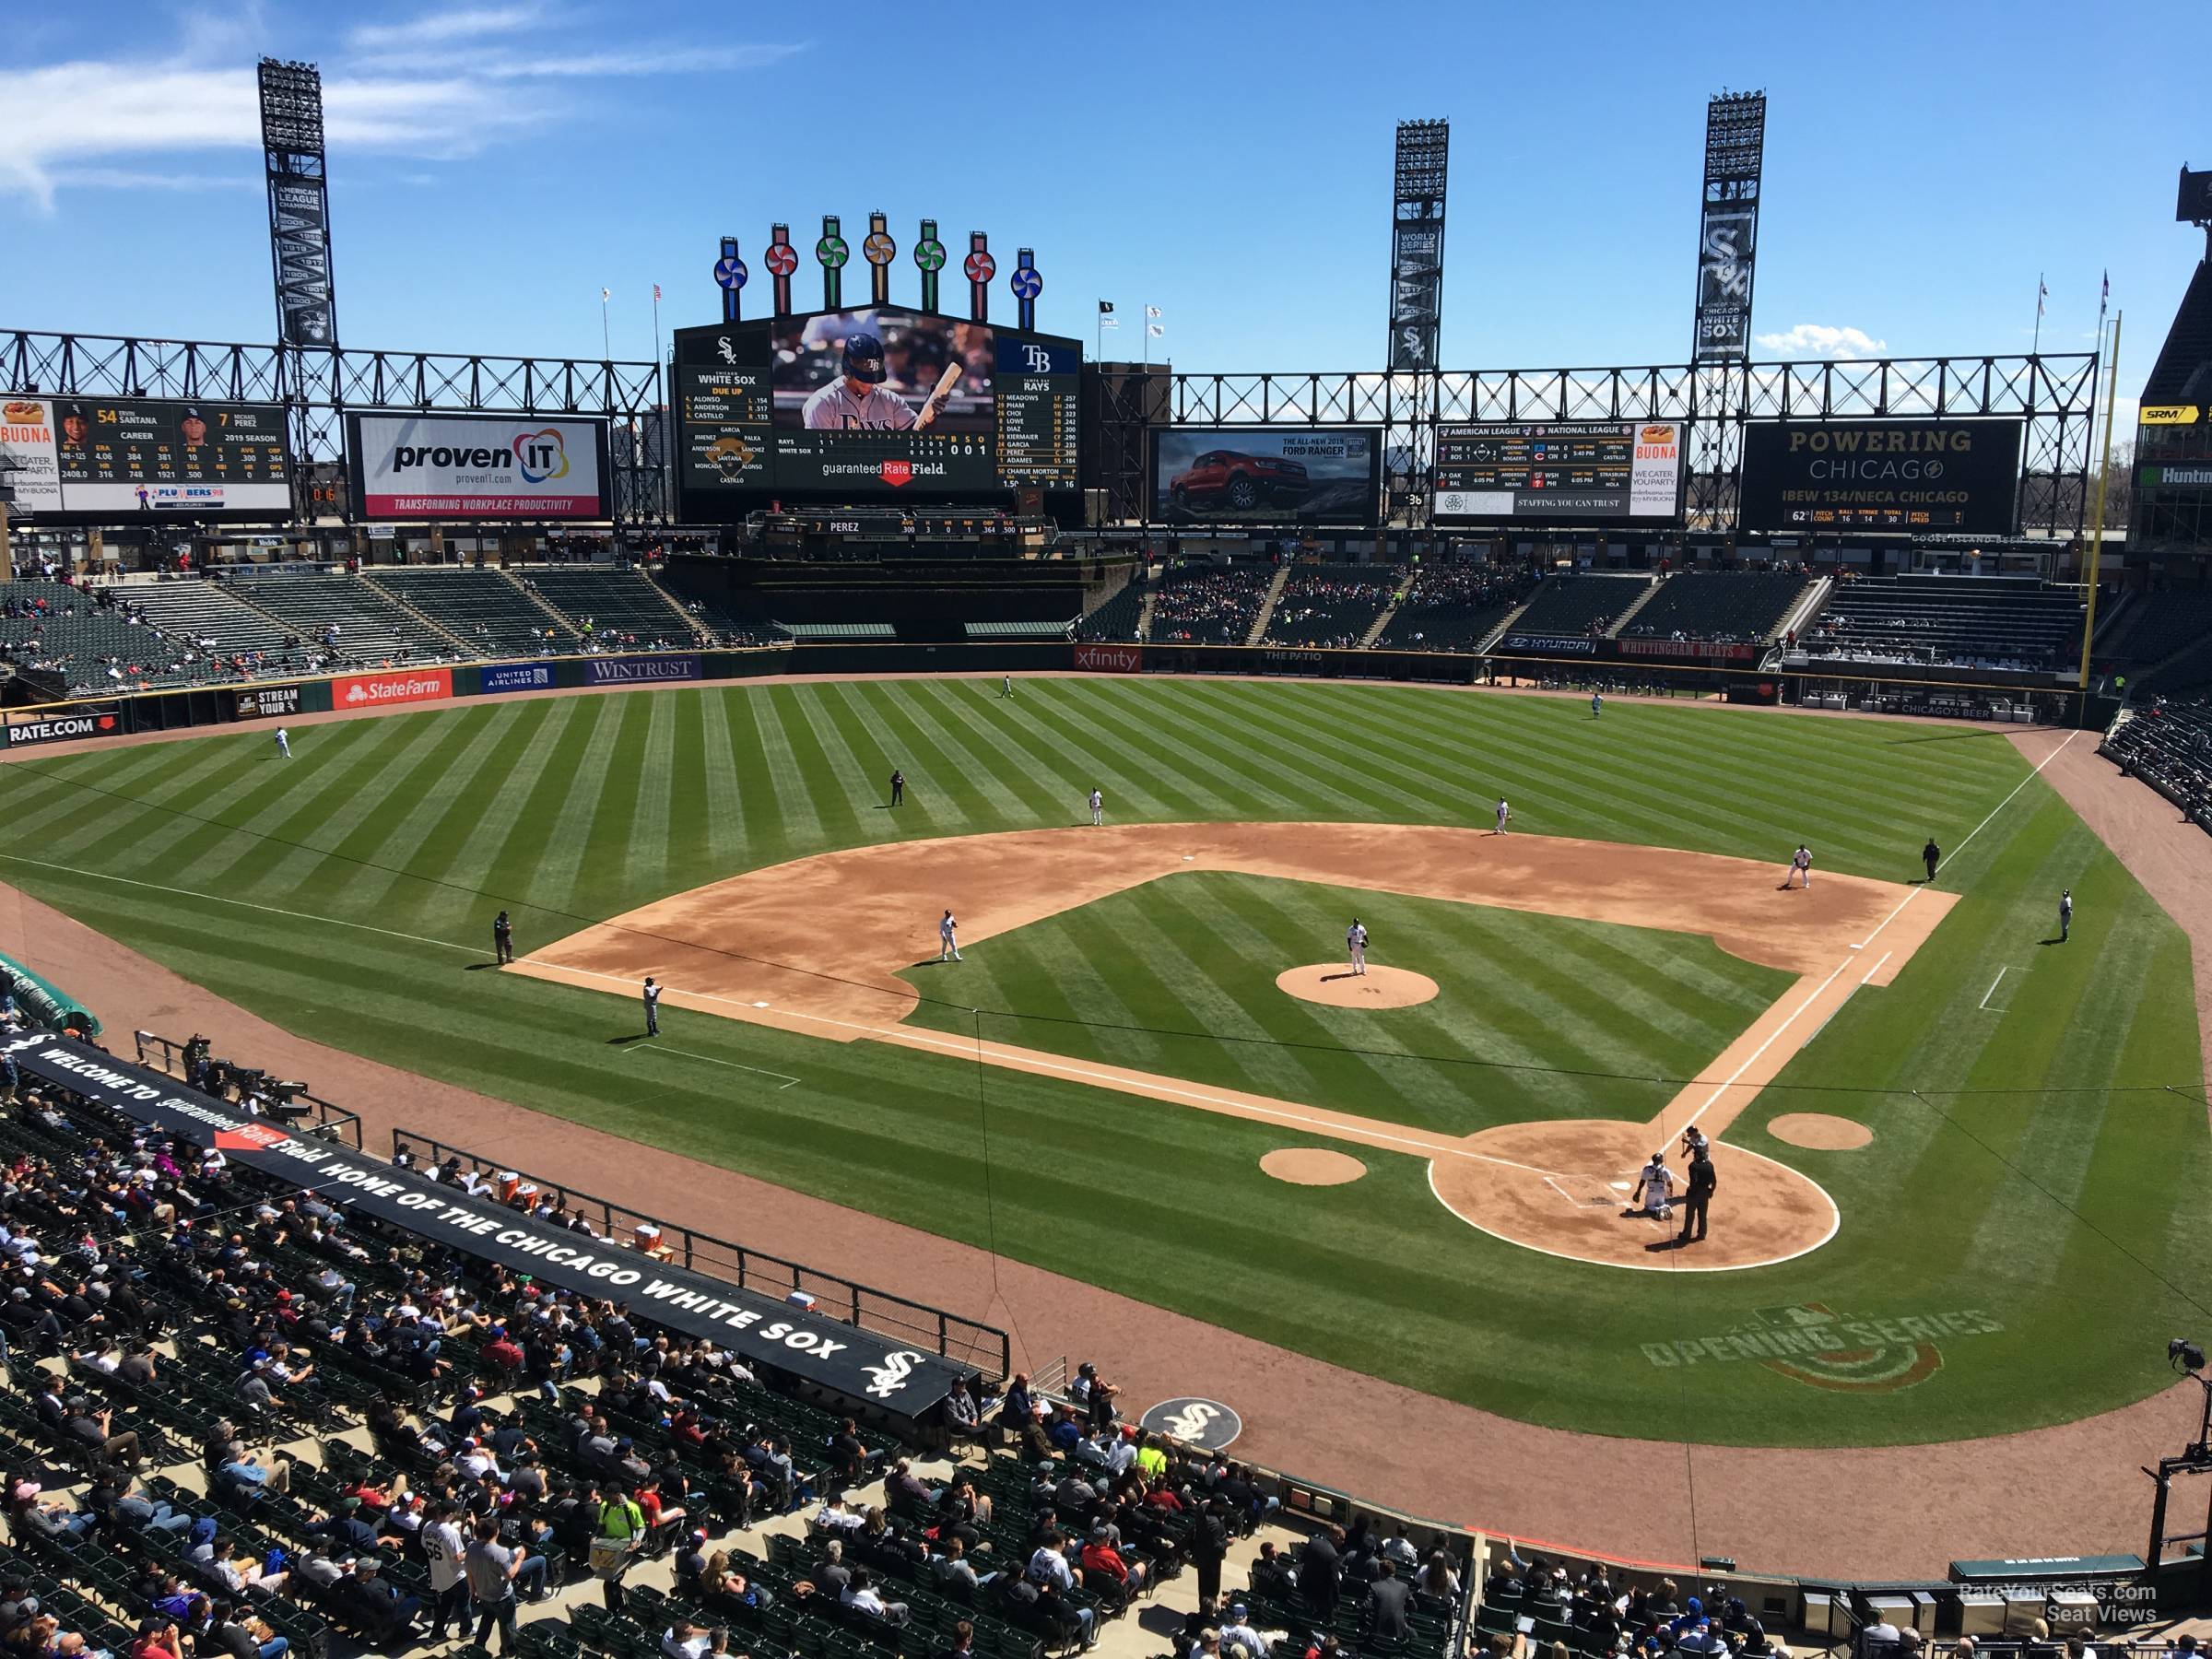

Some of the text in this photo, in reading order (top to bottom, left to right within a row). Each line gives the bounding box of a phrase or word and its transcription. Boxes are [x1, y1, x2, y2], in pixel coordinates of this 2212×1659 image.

[279, 187, 319, 196] AMERICAN
[279, 194, 319, 205] LEAGUE
[279, 202, 320, 211] CHAMPIONS
[1401, 233, 1435, 241] WORLD
[1703, 307, 1740, 315] CHICAGO
[1703, 315, 1739, 324] WHITE
[1701, 324, 1738, 338] SOX
[698, 375, 756, 385] WHITE SOX
[1024, 383, 1049, 391] RAYS
[97, 409, 117, 424] 54
[218, 413, 228, 427] 7
[2146, 410, 2178, 419] SRM
[119, 417, 158, 425] SANTANA
[0, 427, 51, 443] BUONA
[1450, 427, 1521, 436] AMERICAN LEAGUE
[1547, 425, 1619, 435] NATIONAL LEAGUE
[1789, 430, 1972, 453] POWERING
[951, 445, 986, 455] 0 0 1
[1282, 446, 1307, 456] FORD
[1308, 446, 1344, 456] RANGER
[1636, 445, 1677, 459] BUONA
[393, 445, 555, 472] proven IT
[823, 463, 882, 476] guaranteed
[884, 464, 909, 474] Rate
[1810, 460, 1944, 480] CHICAGO
[456, 474, 512, 485] provenIT.com
[1518, 498, 1621, 507] STAFFING YOU CAN TRUST
[1783, 490, 1969, 503] IBEW 134/NECA CHICAGO
[394, 499, 573, 512] TRANSFORMING WORKPLACE PRODUCTIVITY
[816, 522, 859, 532] 7 PEREZ
[1530, 640, 1591, 653] HYUNDAI
[1621, 641, 1734, 658] WHITTINGHAM MEATS
[1078, 648, 1137, 670] xfinity
[1265, 651, 1323, 661] THE PATIO
[496, 670, 531, 680] UNITED
[594, 660, 692, 679] WINTRUST
[488, 677, 532, 687] AIRLINES
[259, 689, 298, 703] STREAM
[259, 702, 285, 714] YOUR
[1901, 704, 1990, 720] CHICAGO'S BEER
[9, 718, 94, 745] RATE.COM
[39, 1048, 848, 1360] WELCOME TO guaranteed Rate Field HOME OF THE CHICAGO WHITE SOX
[1640, 1310, 2005, 1367] OPENING SERIES
[426, 1541, 443, 1561] 56
[1227, 1632, 1243, 1641] FISK
